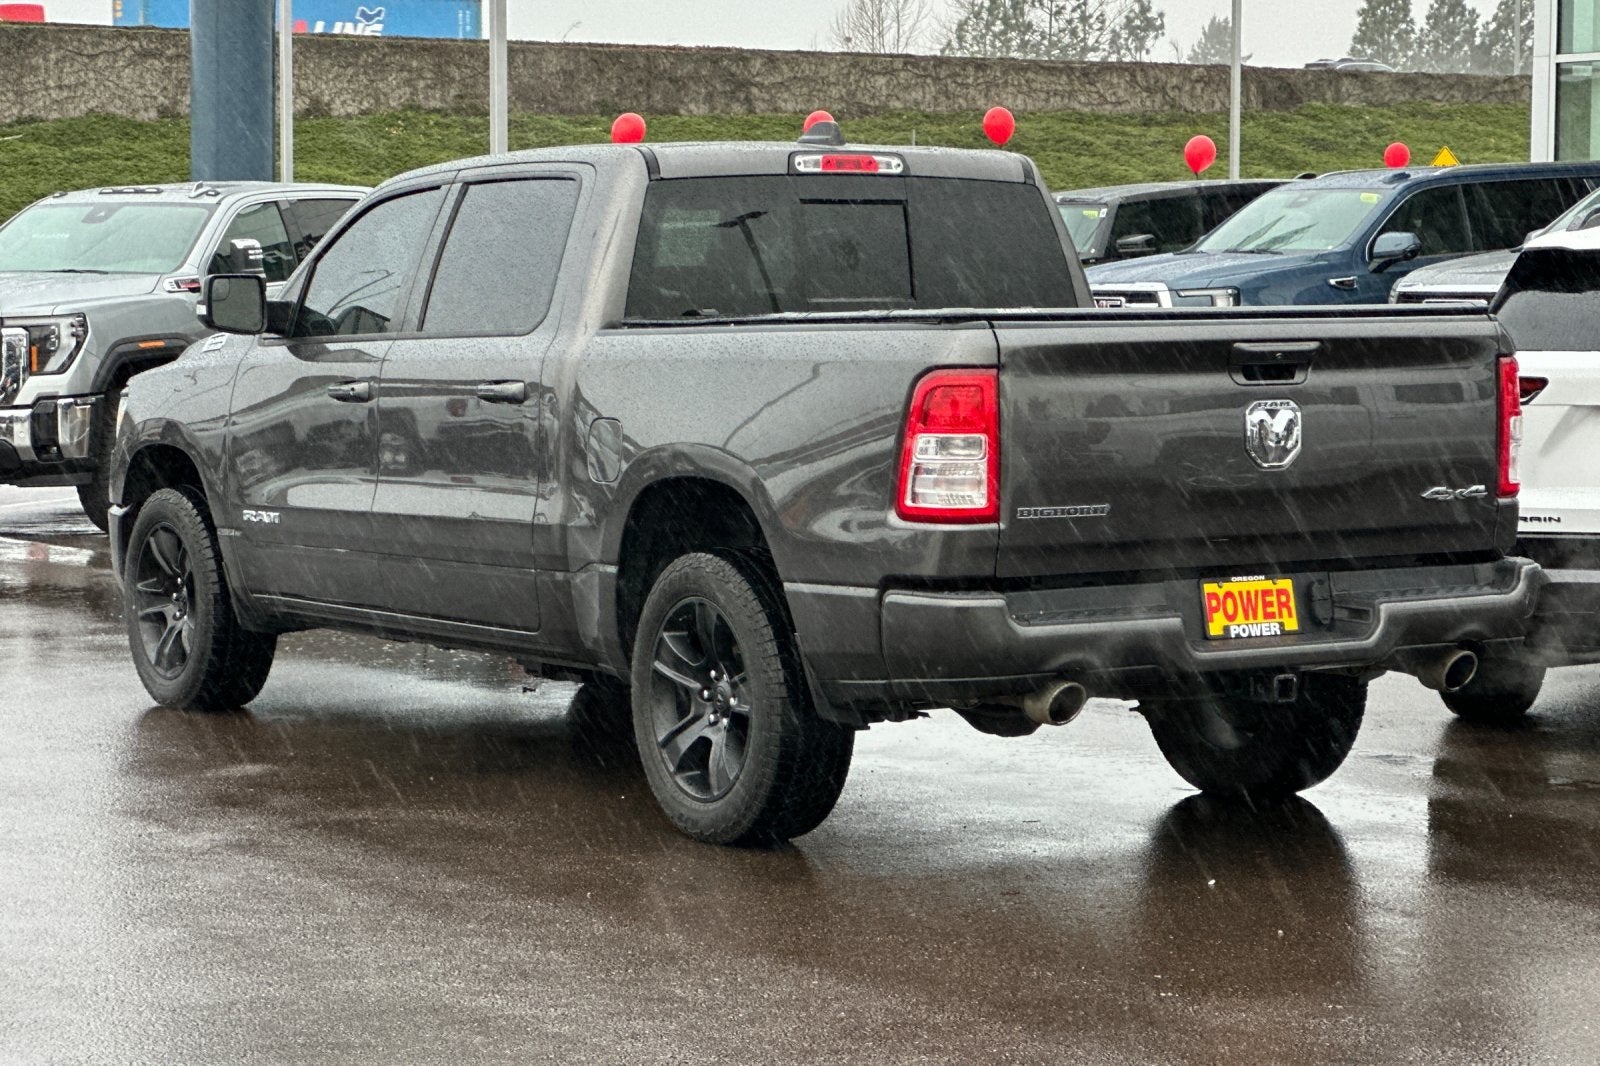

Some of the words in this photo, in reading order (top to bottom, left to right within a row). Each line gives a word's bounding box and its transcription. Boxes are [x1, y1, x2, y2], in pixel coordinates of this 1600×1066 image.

[242, 510, 281, 523] RAM
[1206, 588, 1293, 623] POWER
[1230, 622, 1281, 638] POWER
